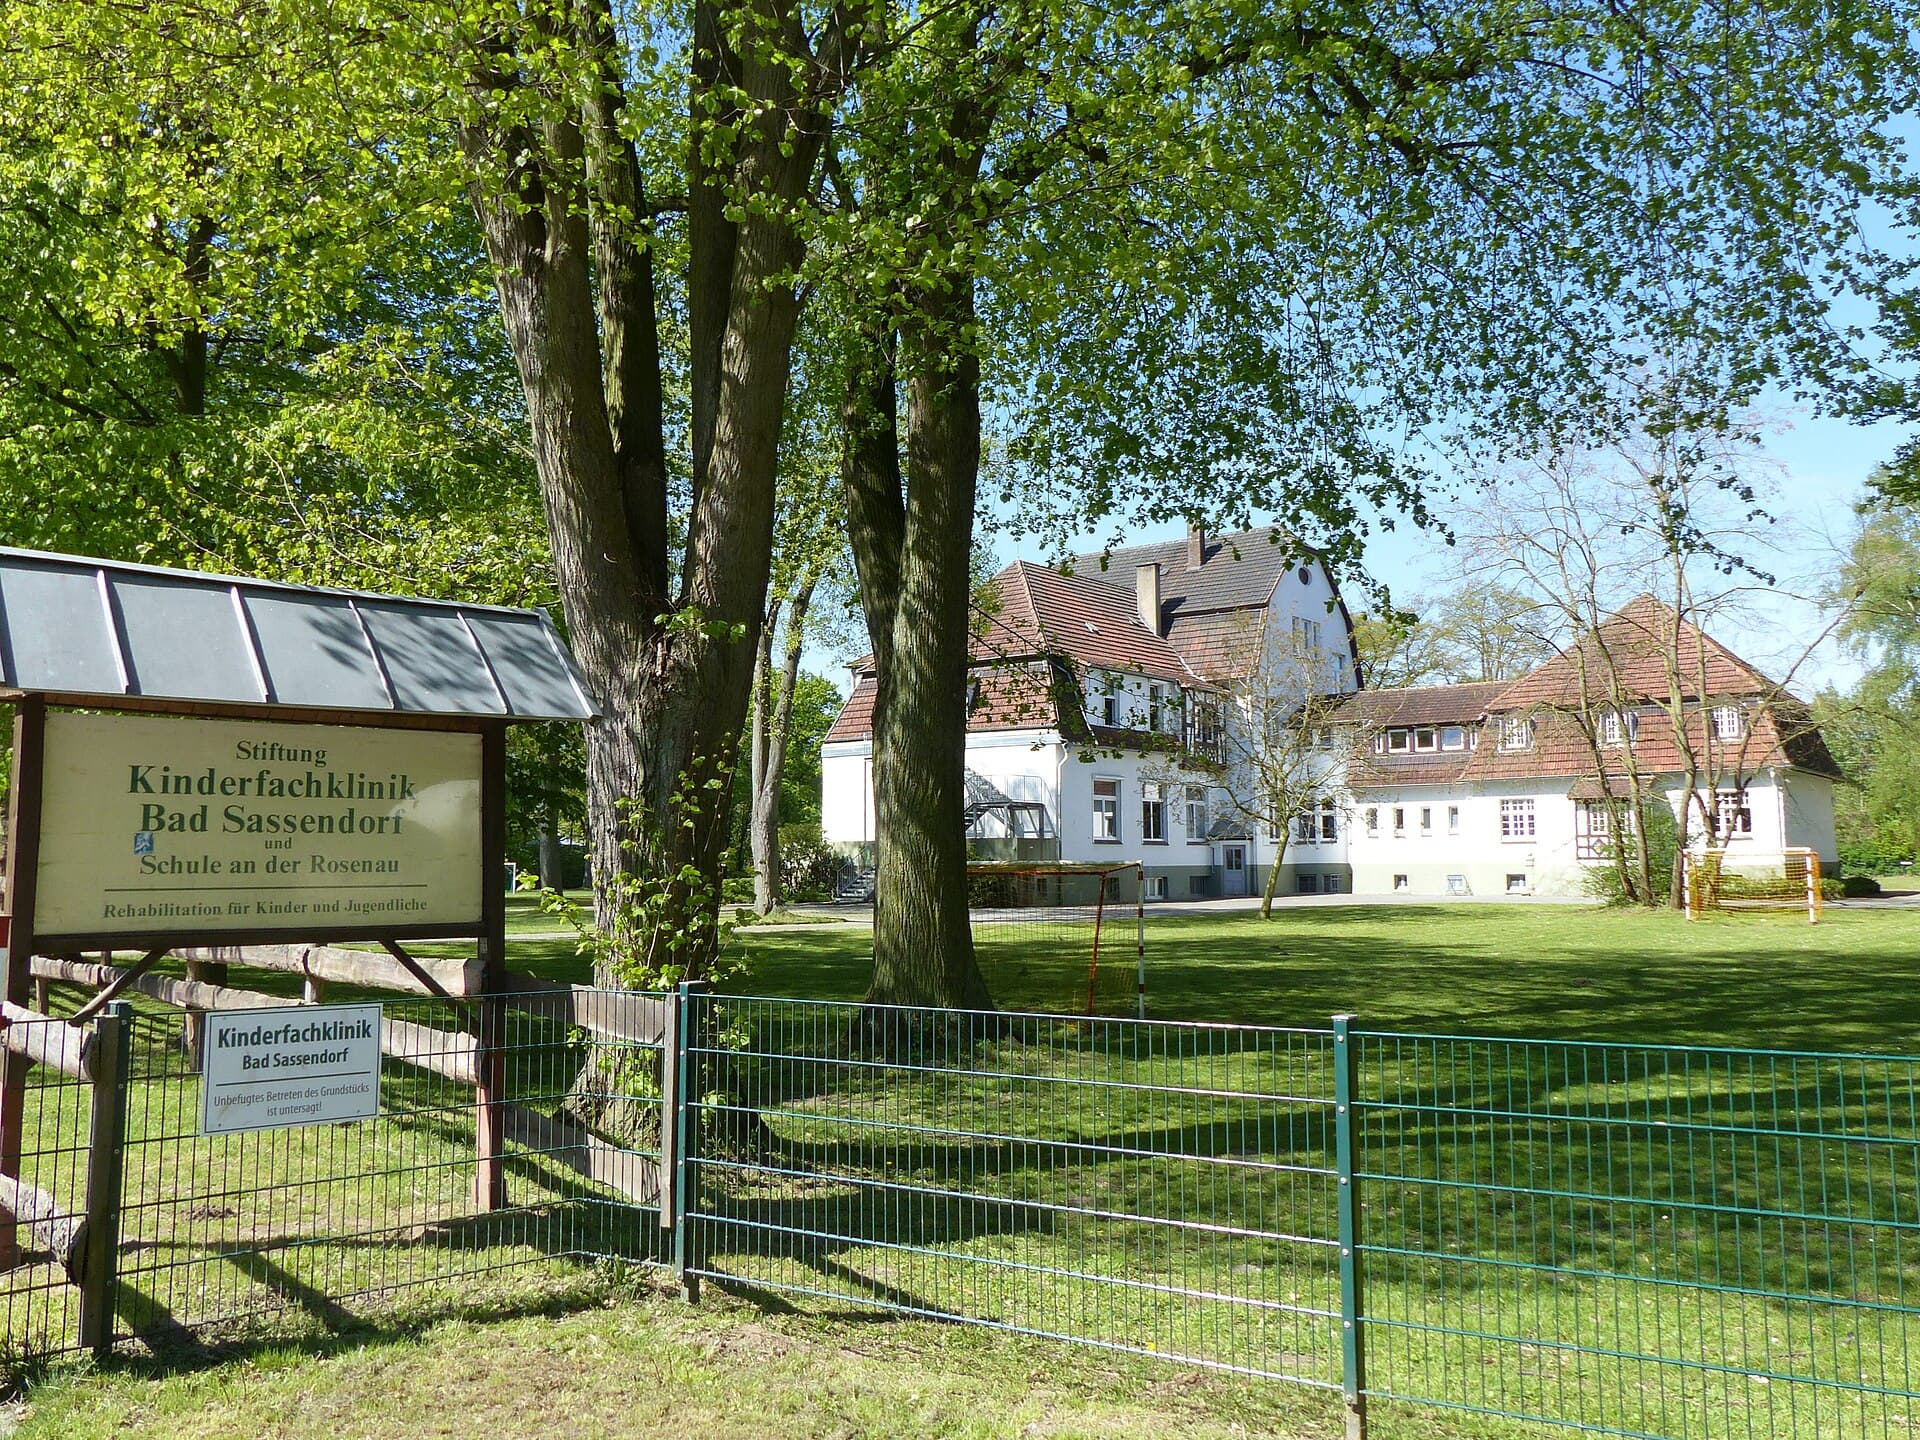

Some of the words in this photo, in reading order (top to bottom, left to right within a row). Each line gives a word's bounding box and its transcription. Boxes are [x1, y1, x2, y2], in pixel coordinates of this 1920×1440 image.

[236, 739, 327, 767] Stiftung
[127, 764, 416, 801] Kinderfachklinik
[140, 803, 208, 834] Bad
[222, 804, 406, 835] Sassendorf
[264, 837, 292, 850] und
[139, 854, 222, 875] Schule
[230, 858, 256, 875] an
[264, 855, 301, 874] der
[310, 856, 400, 874] Rosenau
[104, 902, 221, 919] Rehabilitation
[227, 901, 251, 916] für
[255, 900, 307, 916] Kinder
[312, 899, 340, 914] und
[344, 897, 428, 914] Jugendliche
[218, 1020, 372, 1048] Kinderfachklinik
[243, 1053, 269, 1070] Bad
[273, 1047, 349, 1067] Sassendorf
[214, 1093, 264, 1106] Unbefugtes
[267, 1089, 302, 1101] Betreten
[305, 1087, 319, 1097] des
[320, 1082, 369, 1096] Grundstücks
[267, 1105, 277, 1116] ist
[279, 1102, 322, 1115] untersagt!
